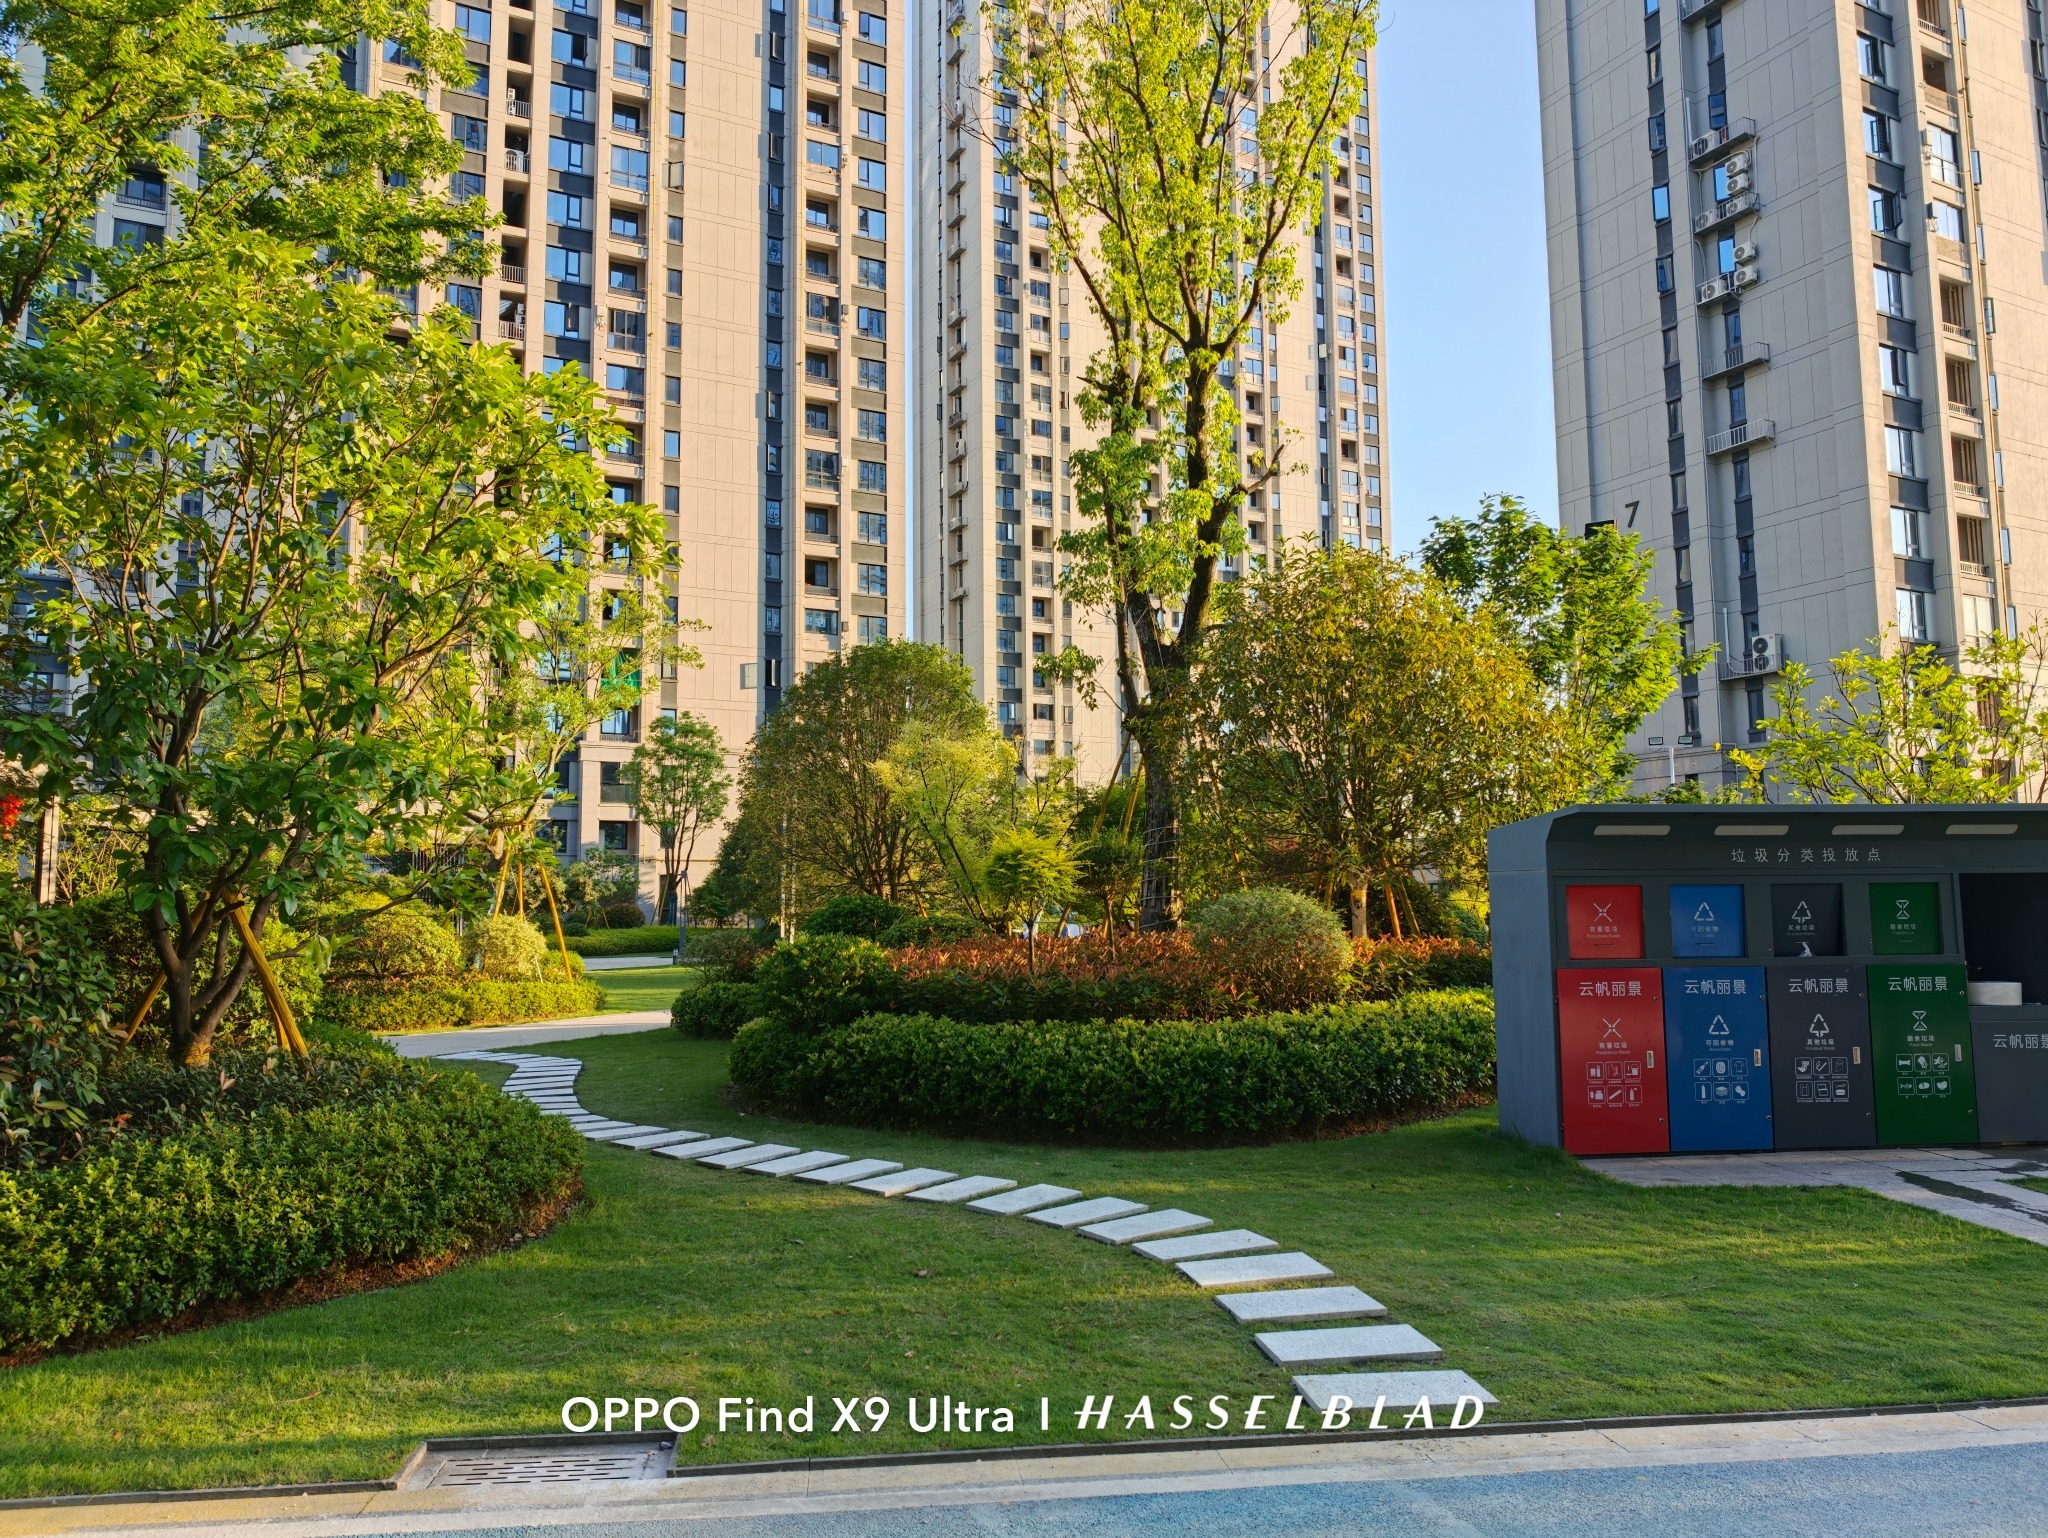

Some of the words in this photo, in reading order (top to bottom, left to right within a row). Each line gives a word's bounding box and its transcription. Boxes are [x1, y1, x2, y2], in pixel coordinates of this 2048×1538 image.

[1624, 500, 1640, 529] 7
[1731, 847, 1881, 863] 垃圾分类投放点
[1579, 981, 1642, 997] 云帆丽景
[1684, 979, 1747, 995] 云帆丽景
[1788, 978, 1849, 994] 云帆丽景
[1888, 976, 1948, 992] 云帆丽景
